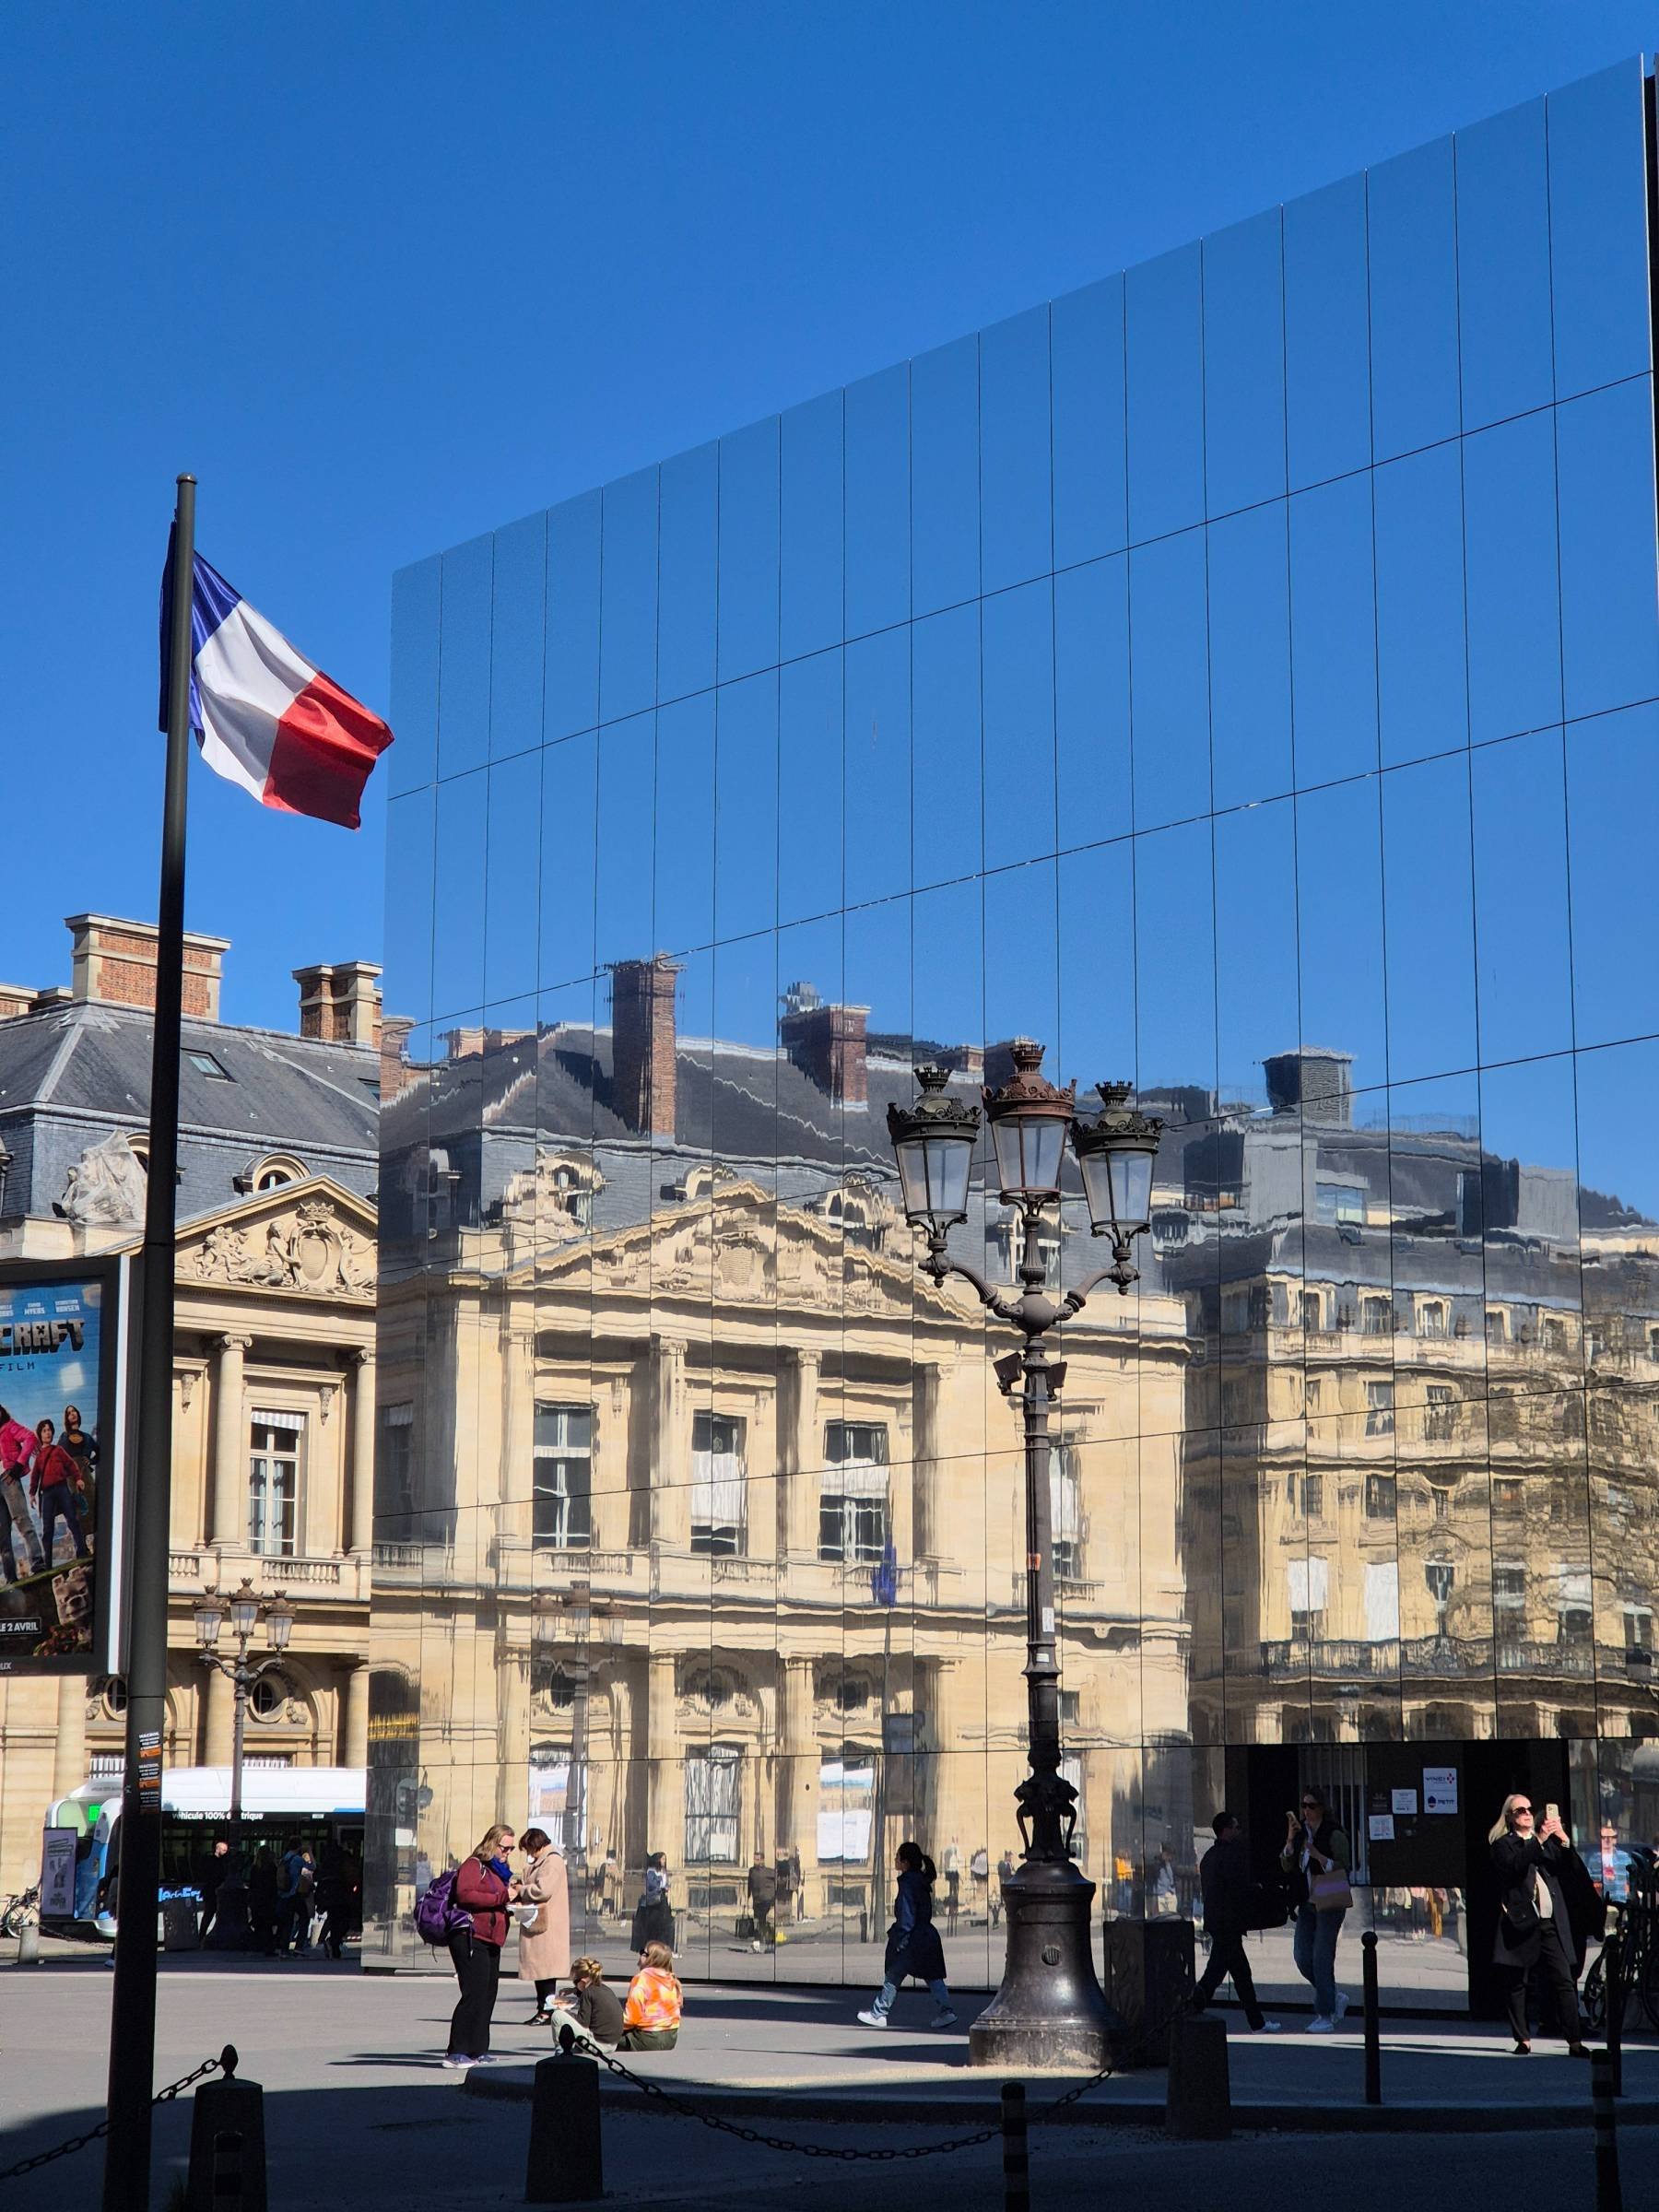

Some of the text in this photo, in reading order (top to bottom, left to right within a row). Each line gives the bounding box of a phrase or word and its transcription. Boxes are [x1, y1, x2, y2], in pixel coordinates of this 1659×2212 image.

[7, 1623, 13, 1632] 2
[14, 1622, 39, 1631] AVRIL
[205, 1811, 226, 1820] 100%
